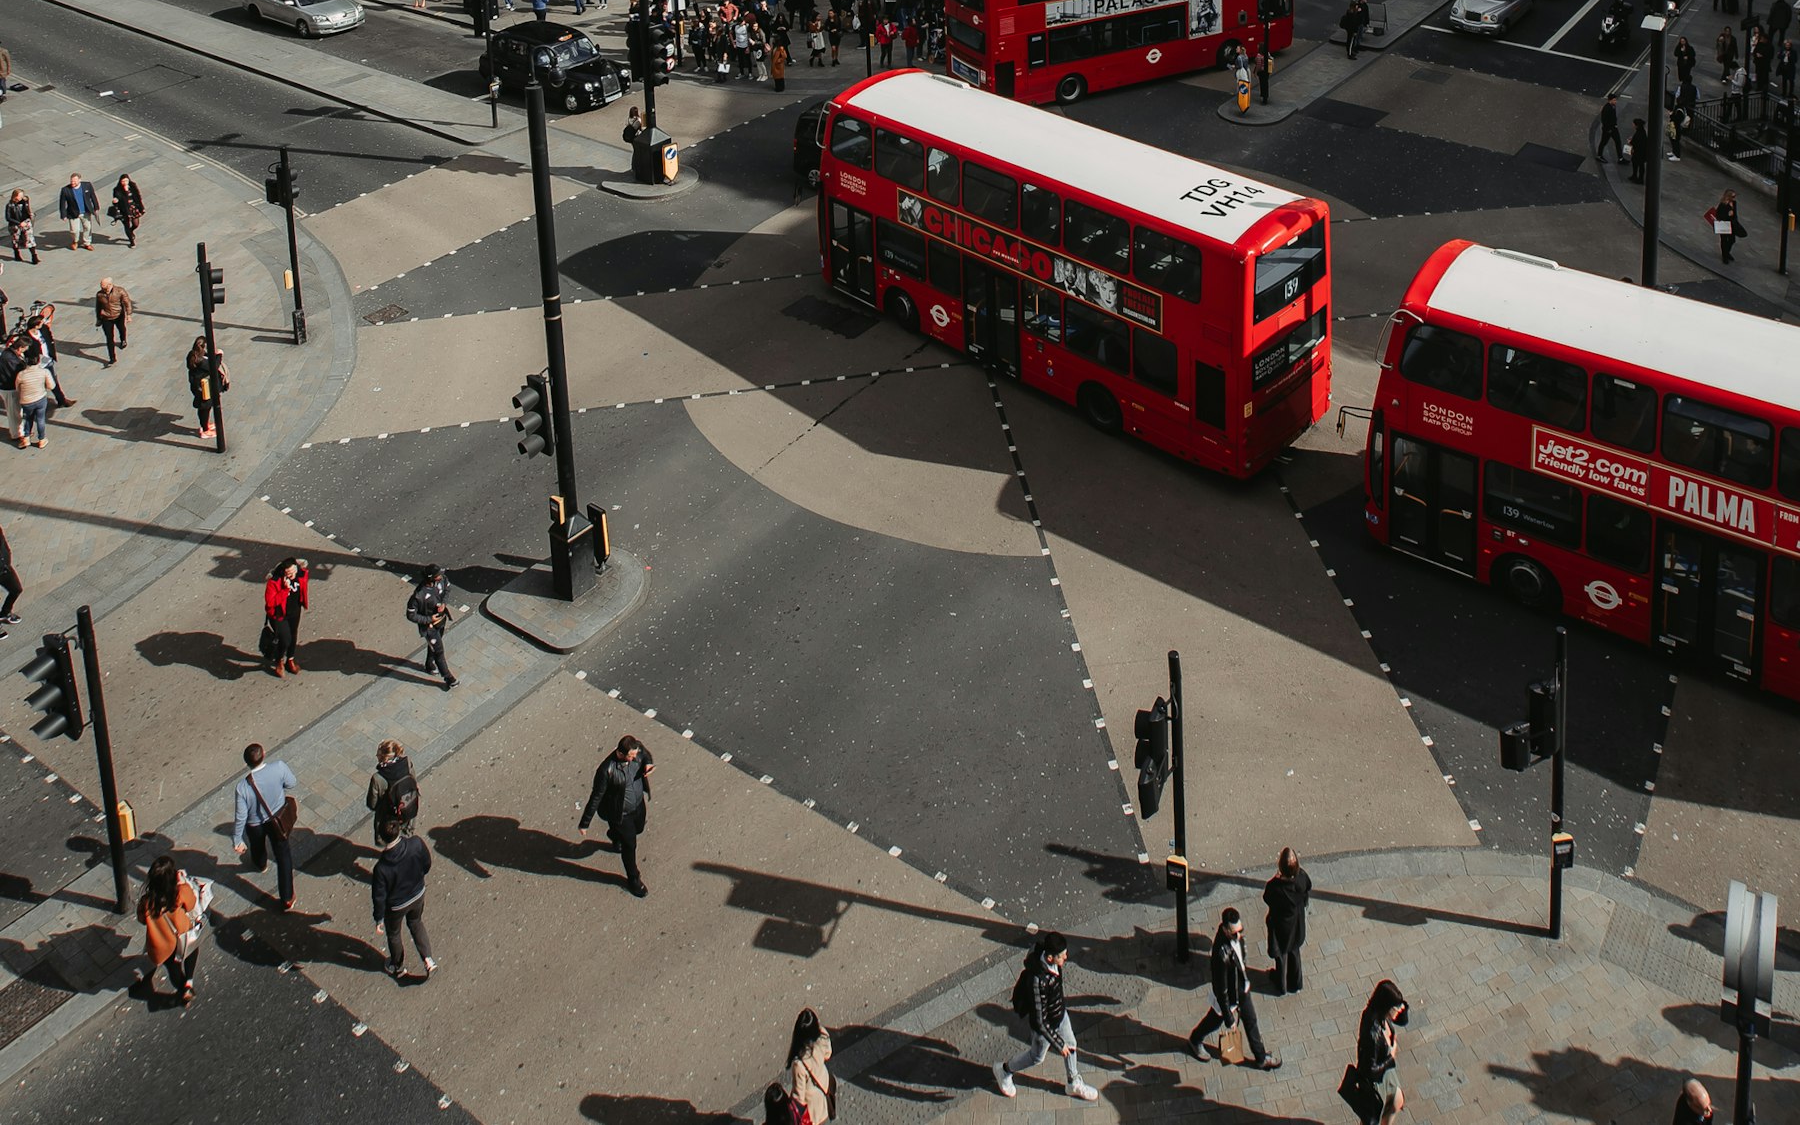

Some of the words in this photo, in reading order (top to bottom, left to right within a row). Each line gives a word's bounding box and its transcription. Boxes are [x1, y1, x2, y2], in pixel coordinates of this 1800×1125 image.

[840, 170, 866, 187] LONDON
[1179, 178, 1232, 202] TDG
[1200, 185, 1265, 217] VH14
[924, 206, 1053, 281] CHICAGO
[1284, 277, 1299, 301] 139
[1255, 345, 1286, 370] LONDON
[1423, 402, 1473, 424] LONDON
[1423, 410, 1473, 431] SOVEREIGN
[1423, 416, 1441, 426] RATP
[1450, 425, 1473, 436] GROUP
[1537, 454, 1586, 478] Friendly
[1588, 469, 1610, 484] low
[1613, 477, 1646, 497] fares
[1503, 505, 1520, 519] 139
[1668, 475, 1756, 534] PALMA
[1779, 510, 1799, 524] FROM
[1506, 529, 1517, 538] BT
